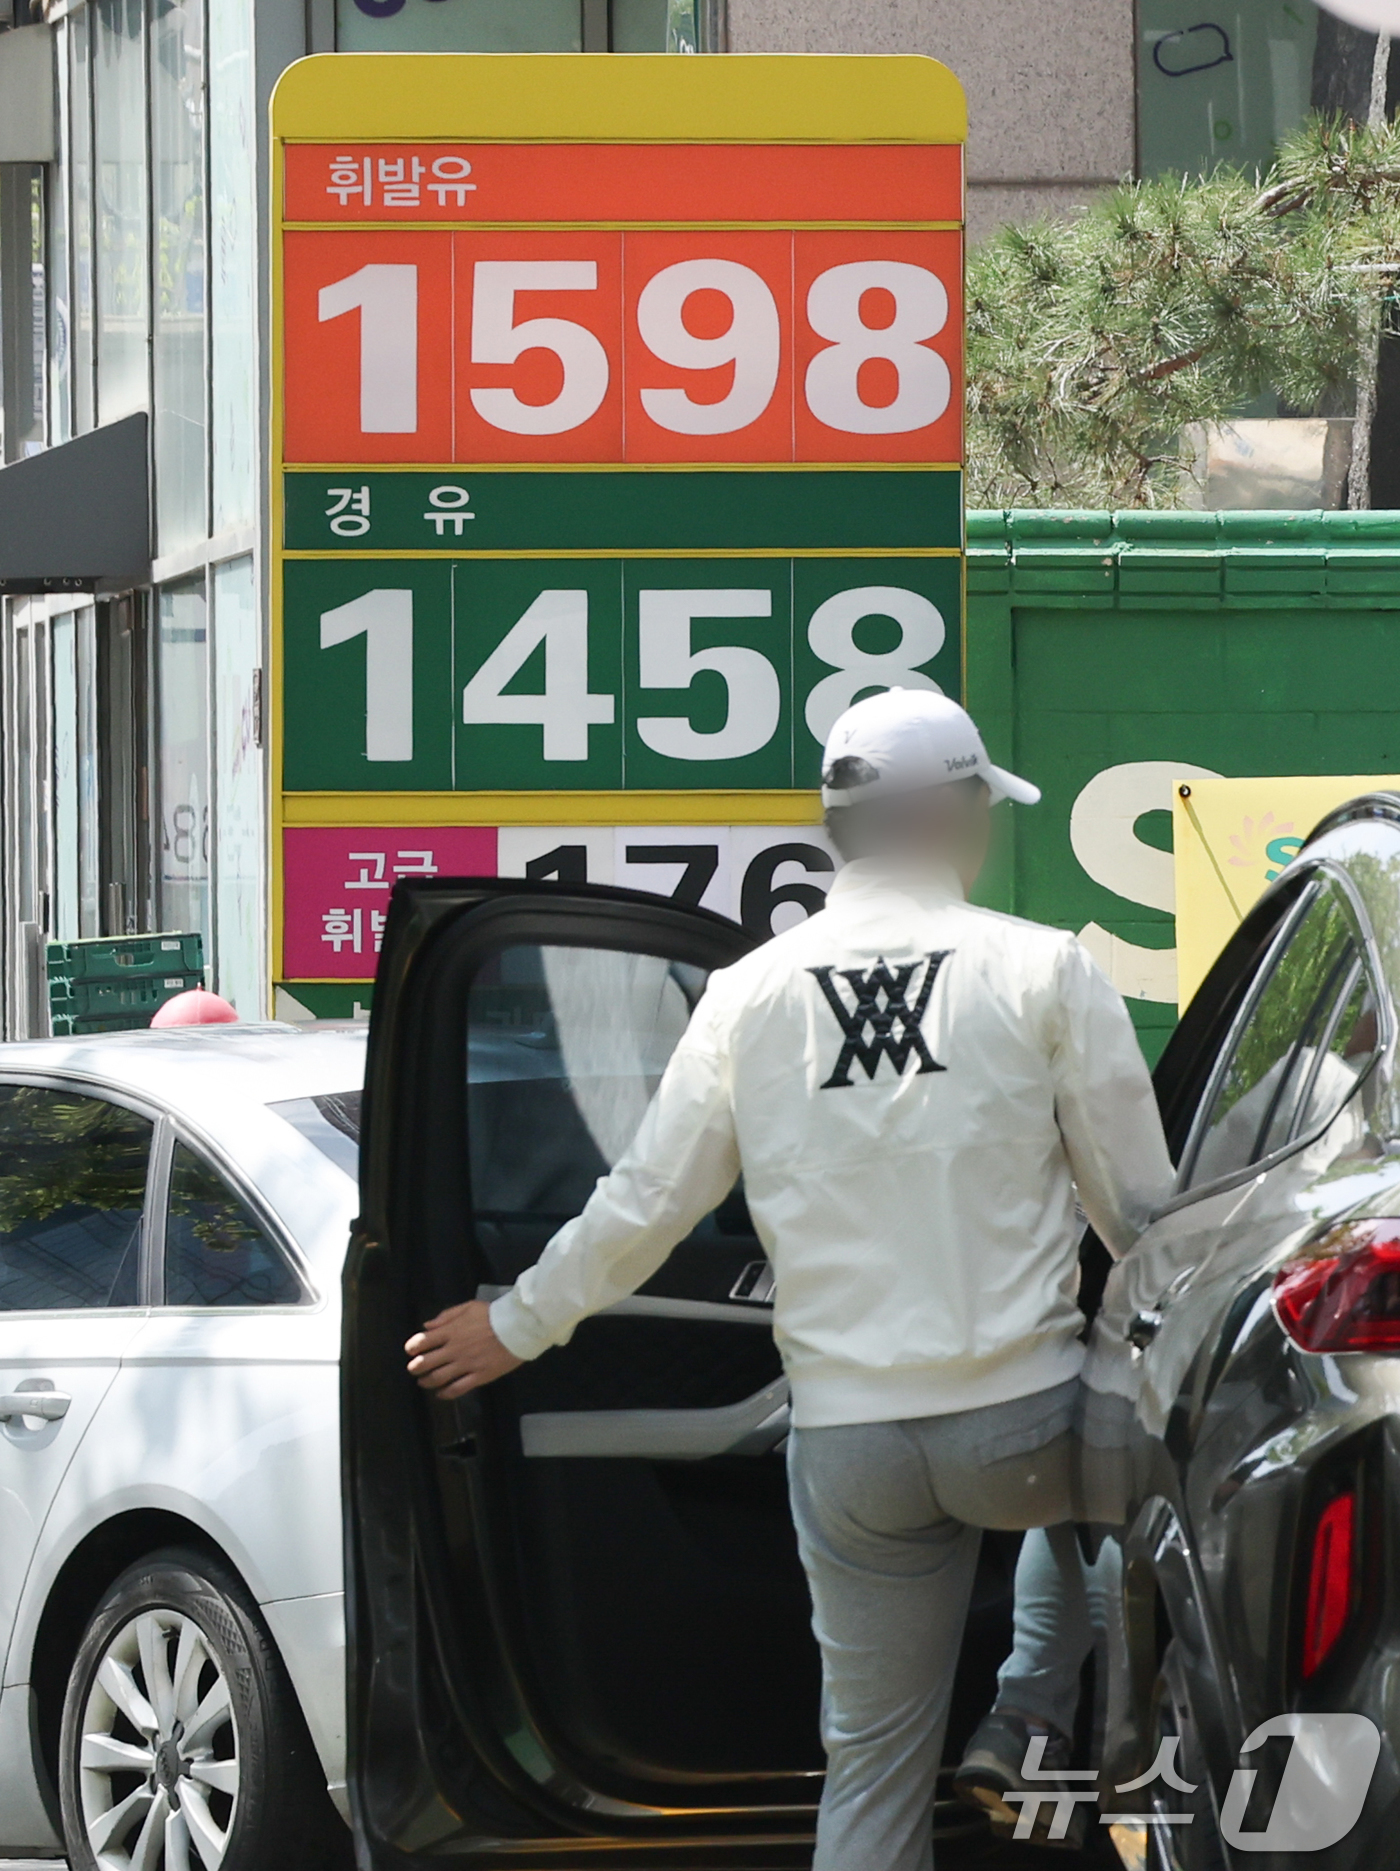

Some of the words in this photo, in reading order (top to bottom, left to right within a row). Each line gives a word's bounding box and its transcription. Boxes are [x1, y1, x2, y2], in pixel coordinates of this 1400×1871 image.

[326, 155, 477, 207] 휘발유
[317, 258, 952, 436] 1598
[320, 586, 947, 762] 1458
